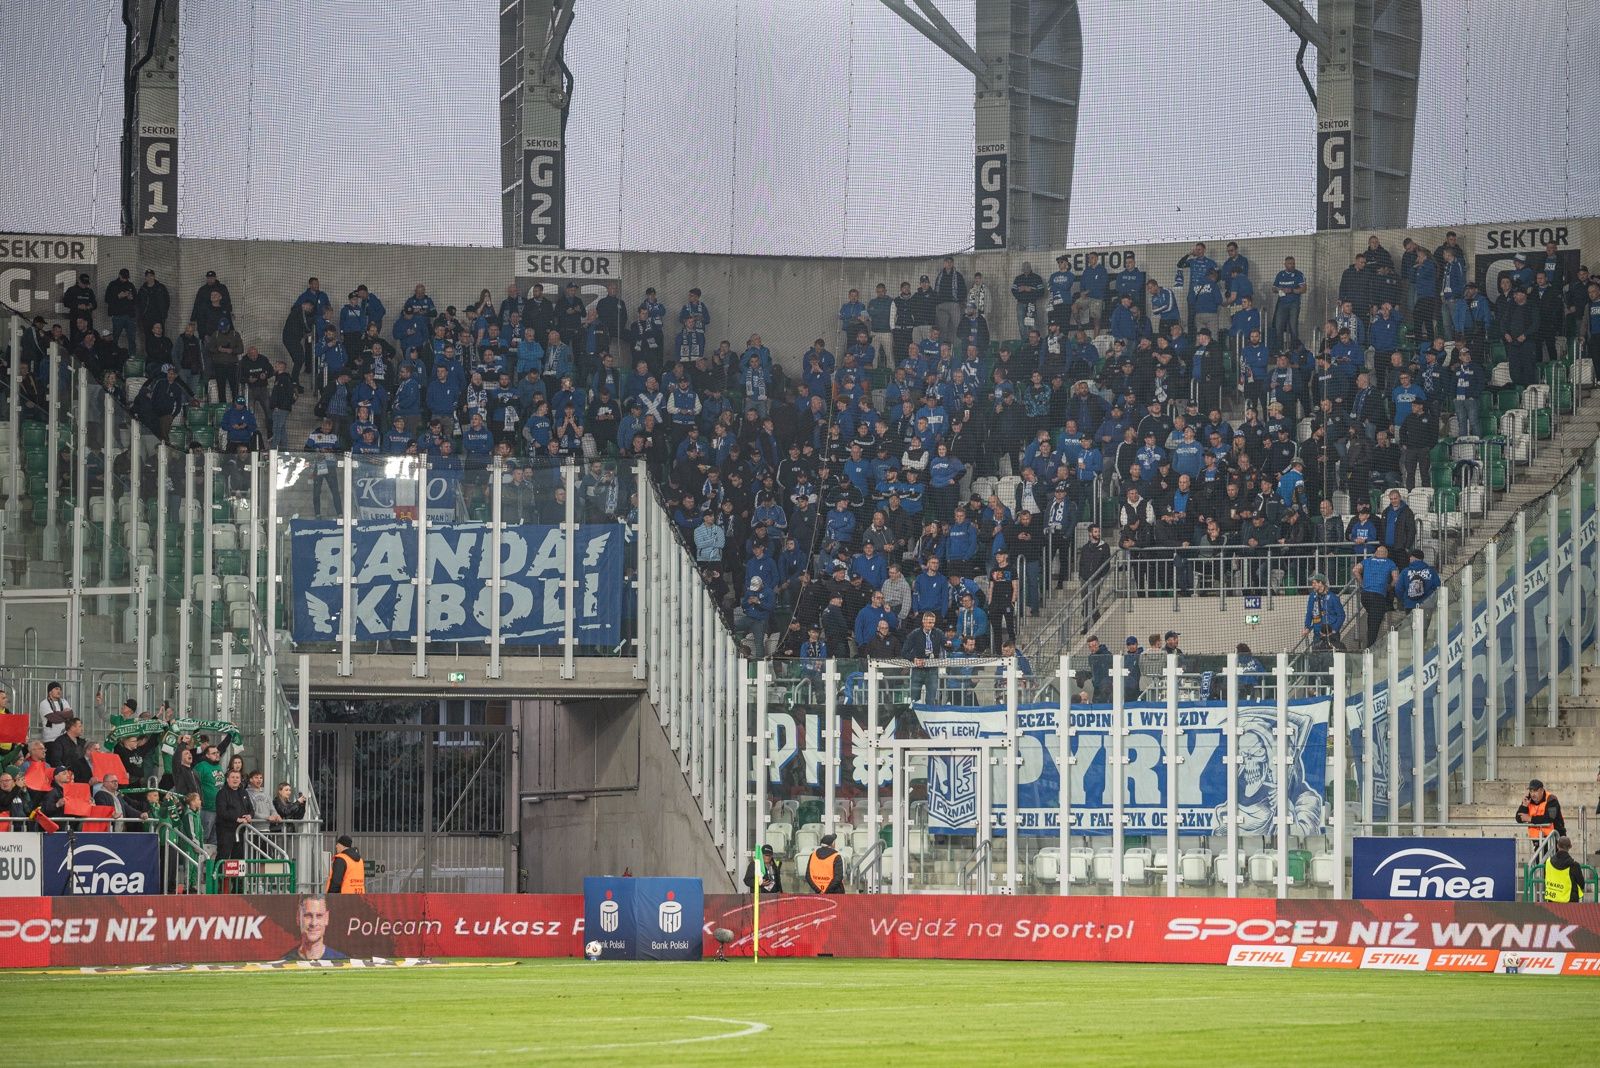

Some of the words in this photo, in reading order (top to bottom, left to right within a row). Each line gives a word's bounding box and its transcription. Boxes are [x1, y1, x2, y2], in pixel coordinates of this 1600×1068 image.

[142, 126, 176, 135] SEKTOR
[1319, 120, 1349, 130] SEKTOR
[526, 139, 559, 148] SEKTOR
[977, 144, 1005, 153] SEKTOR
[1323, 137, 1345, 170] G
[146, 142, 171, 175] G
[530, 155, 554, 187] G
[980, 160, 1001, 192] G
[148, 181, 168, 213] 1
[1323, 176, 1345, 208] 4
[531, 193, 552, 225] 2
[981, 198, 1000, 230] 3
[1487, 227, 1569, 250] SEKTOR
[0, 240, 85, 260] SEKTOR
[526, 254, 610, 275] SEKTOR
[1065, 251, 1136, 272] SETOR
[310, 529, 567, 588] BANDA
[1245, 598, 1256, 608] WC
[1006, 713, 1060, 728] ECZE,
[1070, 713, 1114, 728] DOPIN
[1140, 711, 1209, 726] WYZDY
[952, 726, 975, 737] LECH
[985, 733, 1220, 805] PYRY
[936, 799, 974, 818] POZNAŃ
[1152, 809, 1213, 827] ODAŻNY
[0, 844, 22, 853] MATYKI
[375, 864, 386, 874] 20
[72, 865, 145, 894] Enea
[1389, 868, 1495, 899] Enea
[105, 908, 158, 943] NIŻ
[166, 915, 267, 941] WYNIK
[347, 917, 442, 936] Polecam
[454, 916, 562, 936] Łukasz
[870, 918, 958, 941] Wejdź
[967, 920, 1003, 937] na
[1013, 919, 1135, 943] Sport.pl
[1348, 913, 1420, 946] NIŻ
[1430, 922, 1579, 950] WYNIK
[609, 940, 626, 949] Polski
[651, 940, 668, 950] Bank
[669, 940, 689, 951] Polski
[1234, 951, 1287, 964] STIHL
[1299, 951, 1354, 964] STIHL
[1366, 953, 1420, 966] STIHL
[1433, 954, 1490, 967] STIHL
[1504, 957, 1556, 969] TIHL
